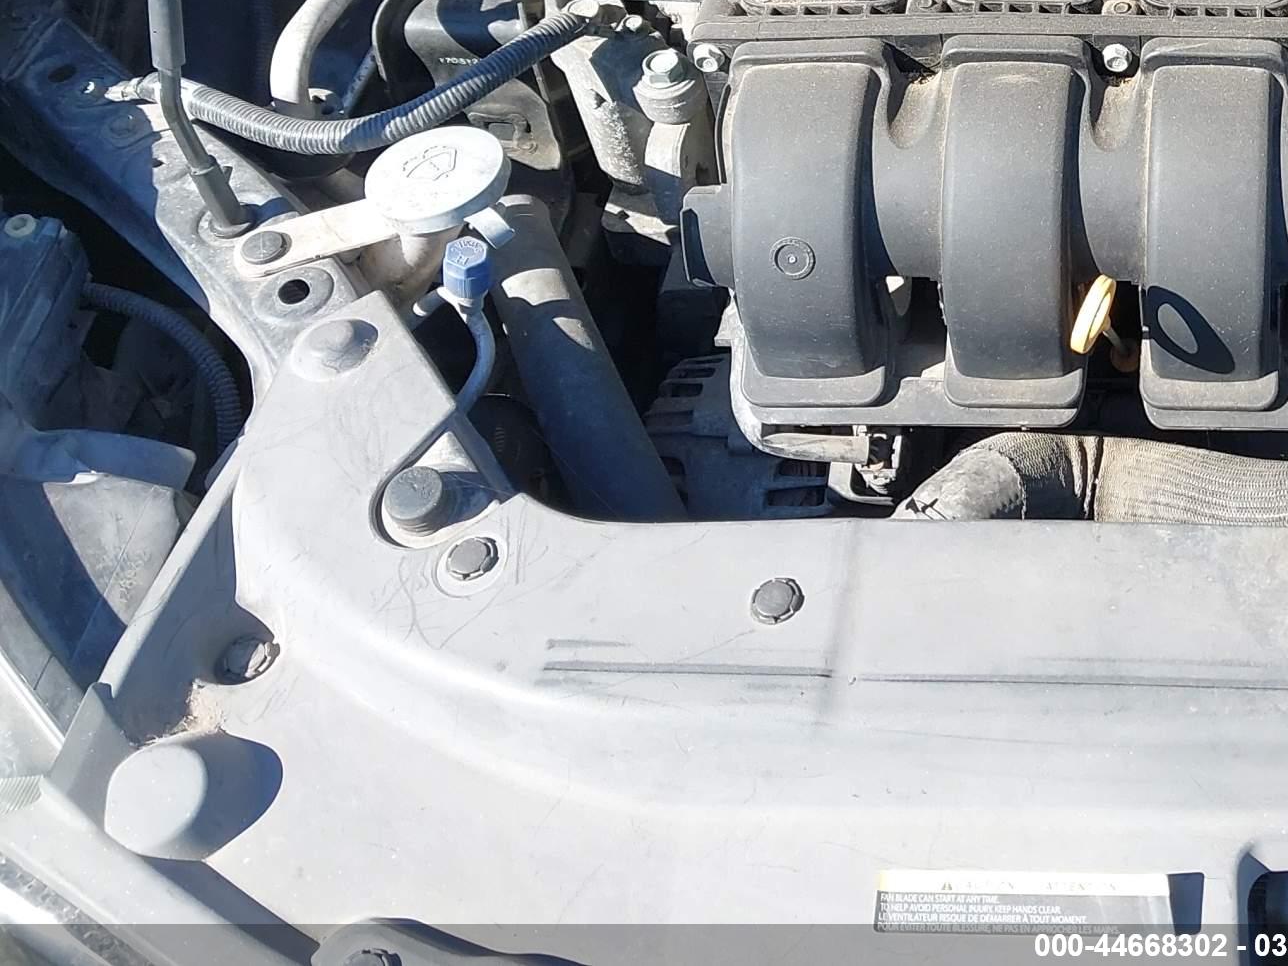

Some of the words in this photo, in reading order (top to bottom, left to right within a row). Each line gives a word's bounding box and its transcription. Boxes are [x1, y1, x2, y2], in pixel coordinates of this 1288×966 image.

[880, 893, 894, 903] FAN
[895, 894, 918, 903] BLADE
[919, 894, 934, 903] CAN
[935, 894, 956, 903] START
[956, 894, 966, 904] AT
[880, 903, 889, 912] TO
[890, 903, 909, 912] HELP
[910, 903, 931, 912] AVOID
[932, 903, 967, 913] PERSONAL
[995, 904, 1011, 913] KEEP
[1013, 905, 1038, 914] HANDS
[878, 913, 888, 922] LE
[888, 913, 938, 922] VENTILATEUR
[939, 913, 967, 923] RISQUE
[968, 913, 979, 923] DE
[1029, 915, 1050, 924] TOUT
